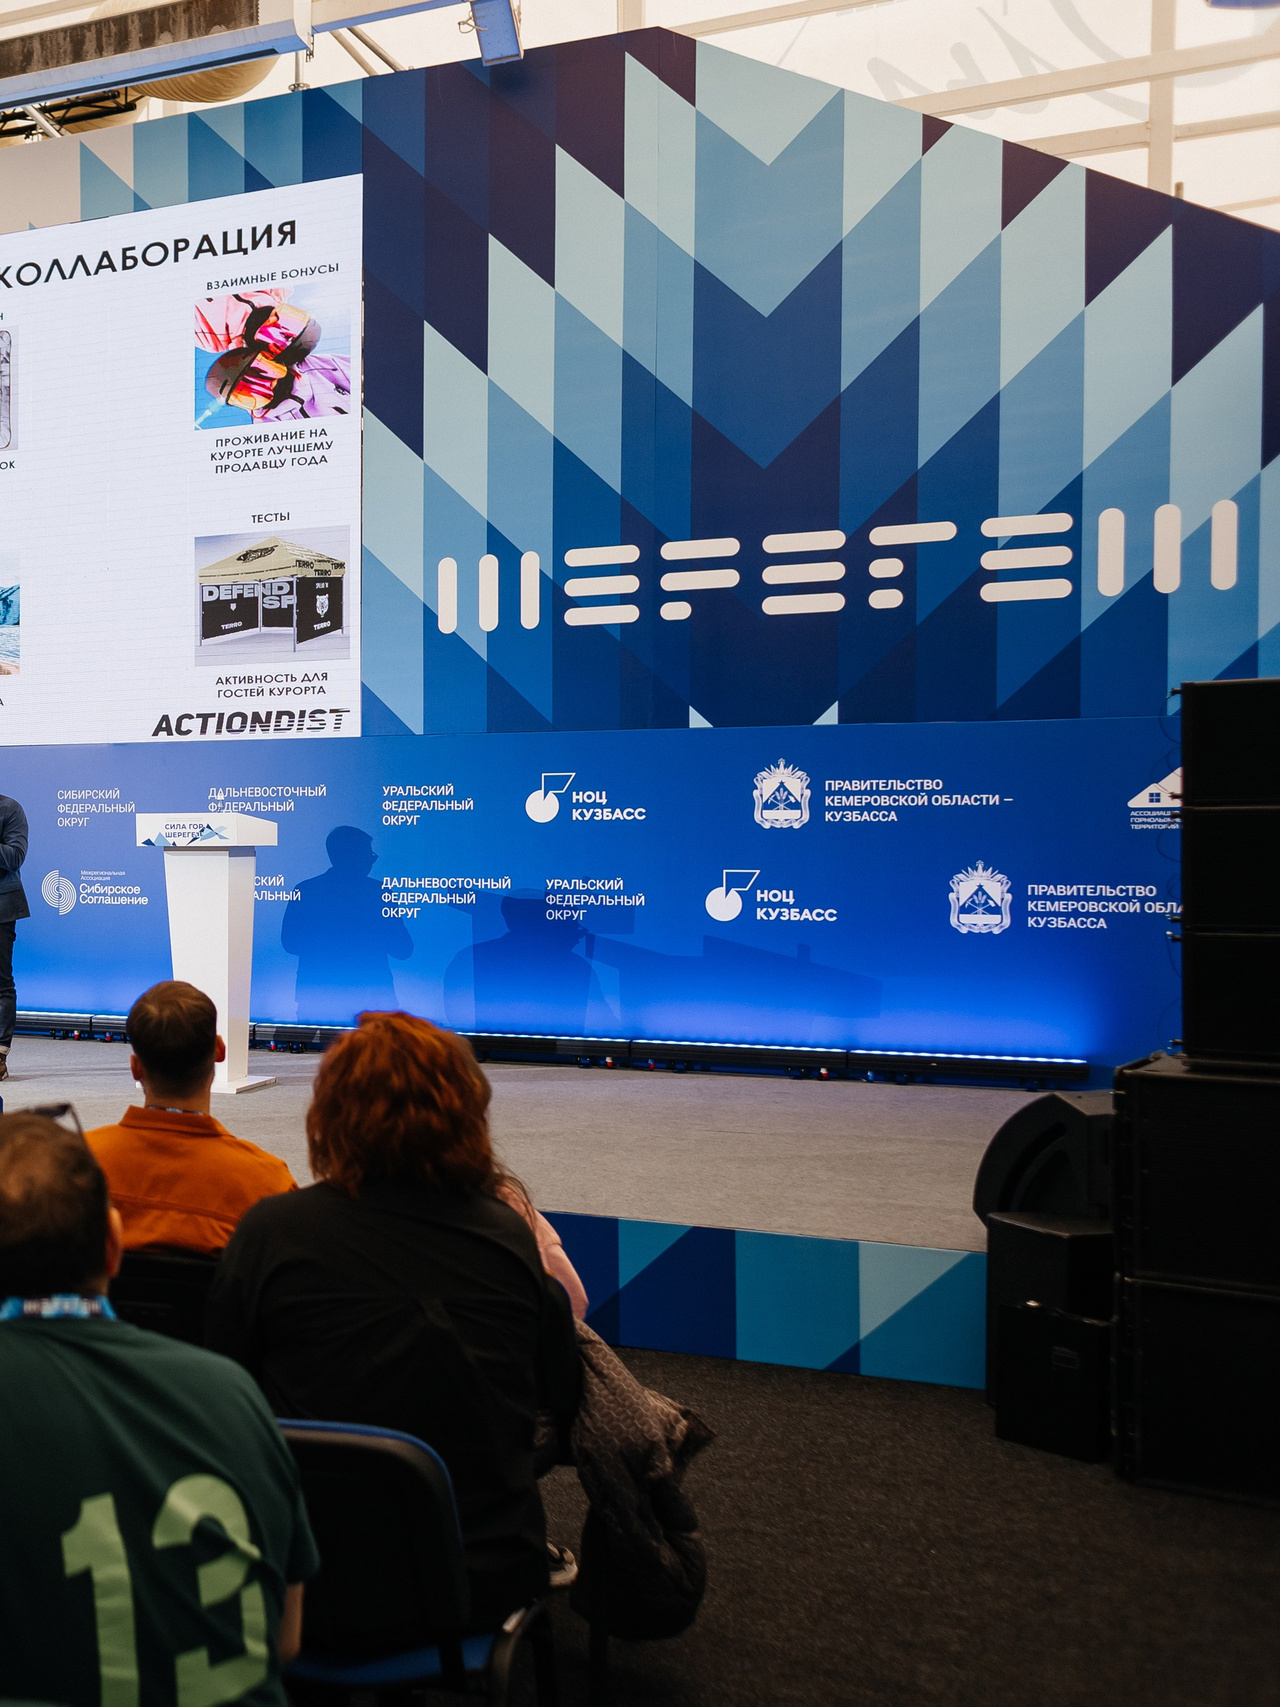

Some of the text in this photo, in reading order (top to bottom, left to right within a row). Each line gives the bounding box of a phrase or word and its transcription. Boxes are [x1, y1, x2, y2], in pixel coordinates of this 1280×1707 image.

[207, 263, 339, 290] ВЗАИМНЫЕ БОНУСЫ
[216, 428, 328, 447] ПРОЖИВАНИЕ НА
[210, 441, 334, 461] КУРОРТЕ ЛУЧШЕМУ
[215, 455, 328, 474] ПРОДАВЦУ ГОДА
[251, 512, 290, 523] ТЕСТЫ
[202, 581, 290, 602] DEFEND
[216, 672, 328, 686] АКТИВНОСТЬ ДЛЯ
[218, 685, 326, 698] ГОСТЕЙ КУРОРТА
[152, 708, 351, 737] ACTIONDIST
[208, 784, 327, 799] ДАЛЬНЕВОСТОЧНЫЙ
[382, 783, 454, 796] УРАЛЬСКИЙ
[825, 779, 943, 791] ПРАВИТЕЛЬСТВО
[57, 787, 120, 800] СИБИРСКИЙ
[572, 790, 608, 805] НОЦ
[825, 793, 928, 807] КЕМЕРОВСКОЙ
[931, 794, 999, 806] ОБЛАСТИ
[57, 801, 136, 814] ФЕДЕРАЛЬНЫЙ
[208, 799, 295, 813] ФДЕРАЛЬНЫЙ
[382, 798, 474, 811] ФЕДЕРАЛЬНЫЙ
[382, 815, 420, 826] ОКРУГ
[572, 807, 646, 821] КУЗБАСС
[825, 811, 898, 822] КУЗБАССА
[57, 817, 90, 827] ОКРУГ
[79, 883, 140, 895] Сибирское
[381, 875, 511, 890] ДАЛЬНЕВОСТОЧНЫЙ
[546, 877, 624, 891] УРАЛЬСКИЙ
[756, 889, 795, 904] НОЦ
[1027, 884, 1157, 896] ПРАВИТЕЛЬСТВО
[79, 894, 149, 905] Соглашение
[381, 892, 476, 904] ФЕДЕРАЛЬНЫЙ
[546, 892, 645, 906] ФЕДЕРАЛЬНЫЙ
[381, 907, 421, 918] ОКРУГ
[1027, 899, 1141, 913] КЕМЕРОВСКОЙ
[546, 909, 587, 920] ОКРУГ
[756, 907, 838, 922] КУЗБАСС
[1027, 917, 1107, 929] КУЗБАССА
